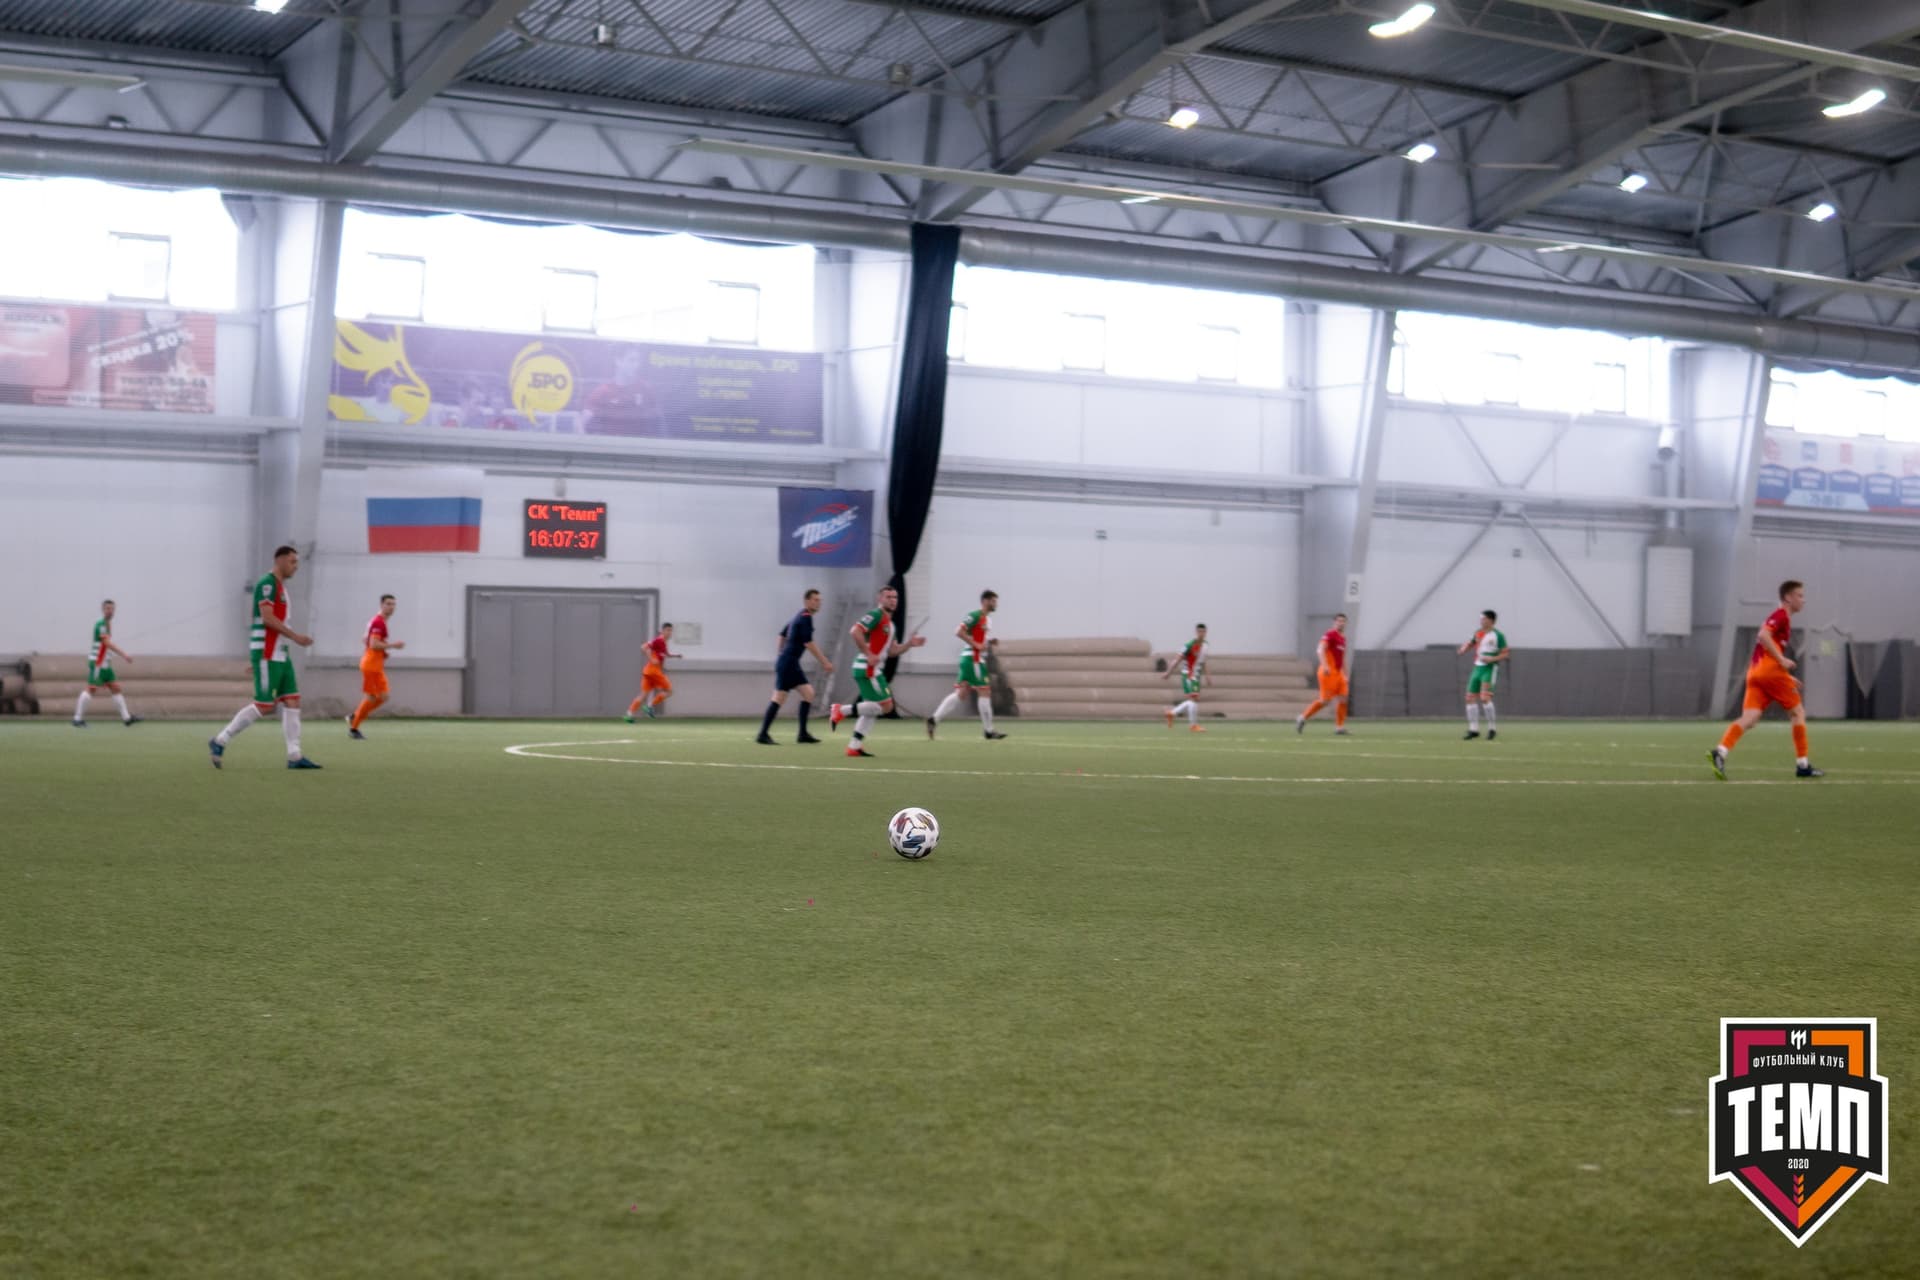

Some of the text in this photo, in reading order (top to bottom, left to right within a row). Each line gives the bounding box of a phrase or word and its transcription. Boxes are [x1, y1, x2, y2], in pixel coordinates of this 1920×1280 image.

[527, 503, 605, 522] СК "Темп"
[528, 529, 600, 549] 16:07:37
